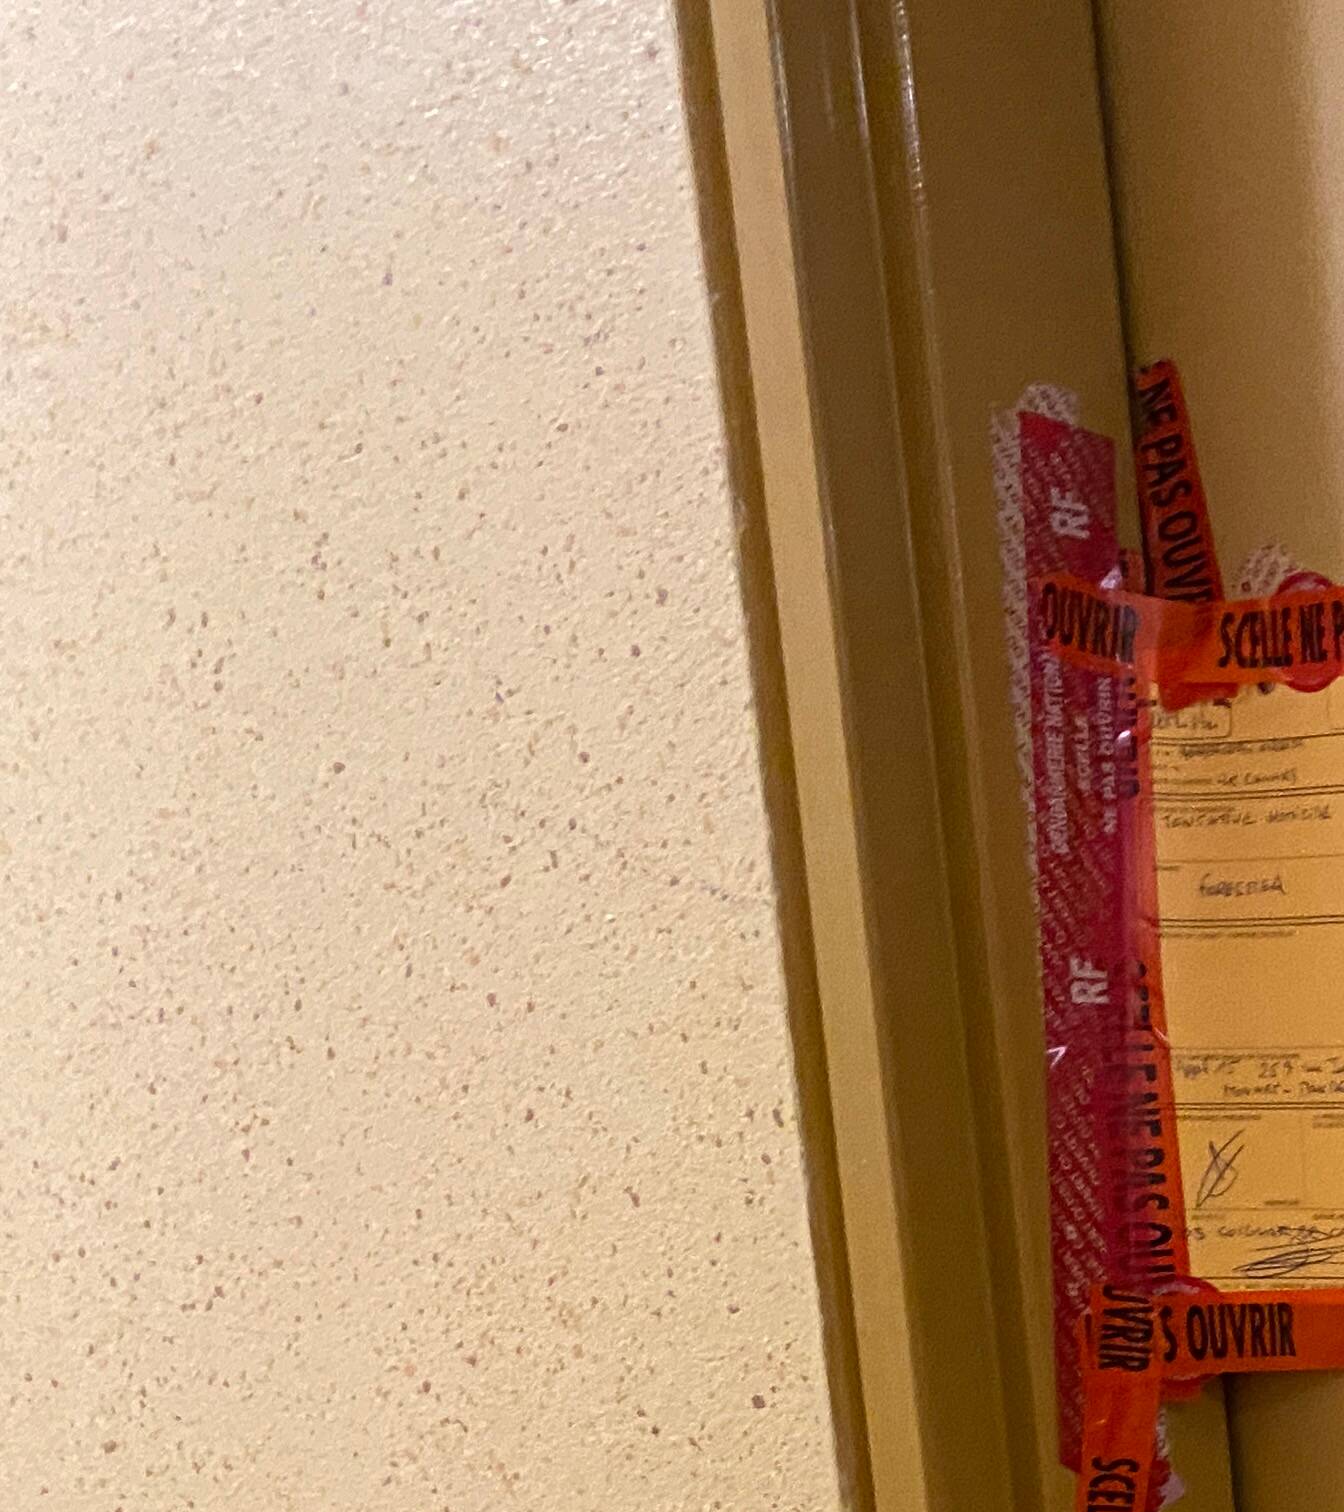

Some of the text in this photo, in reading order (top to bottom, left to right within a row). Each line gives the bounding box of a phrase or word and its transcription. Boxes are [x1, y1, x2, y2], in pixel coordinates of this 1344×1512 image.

[1137, 379, 1178, 427] NE
[1140, 433, 1194, 508] PAS
[1050, 487, 1090, 540] RF
[1040, 582, 1138, 664] OUVRIR
[1218, 607, 1293, 668] SCELLE
[1299, 602, 1328, 664] NE
[1070, 955, 1110, 1005] RF
[1186, 1302, 1297, 1361] OUVRIR
